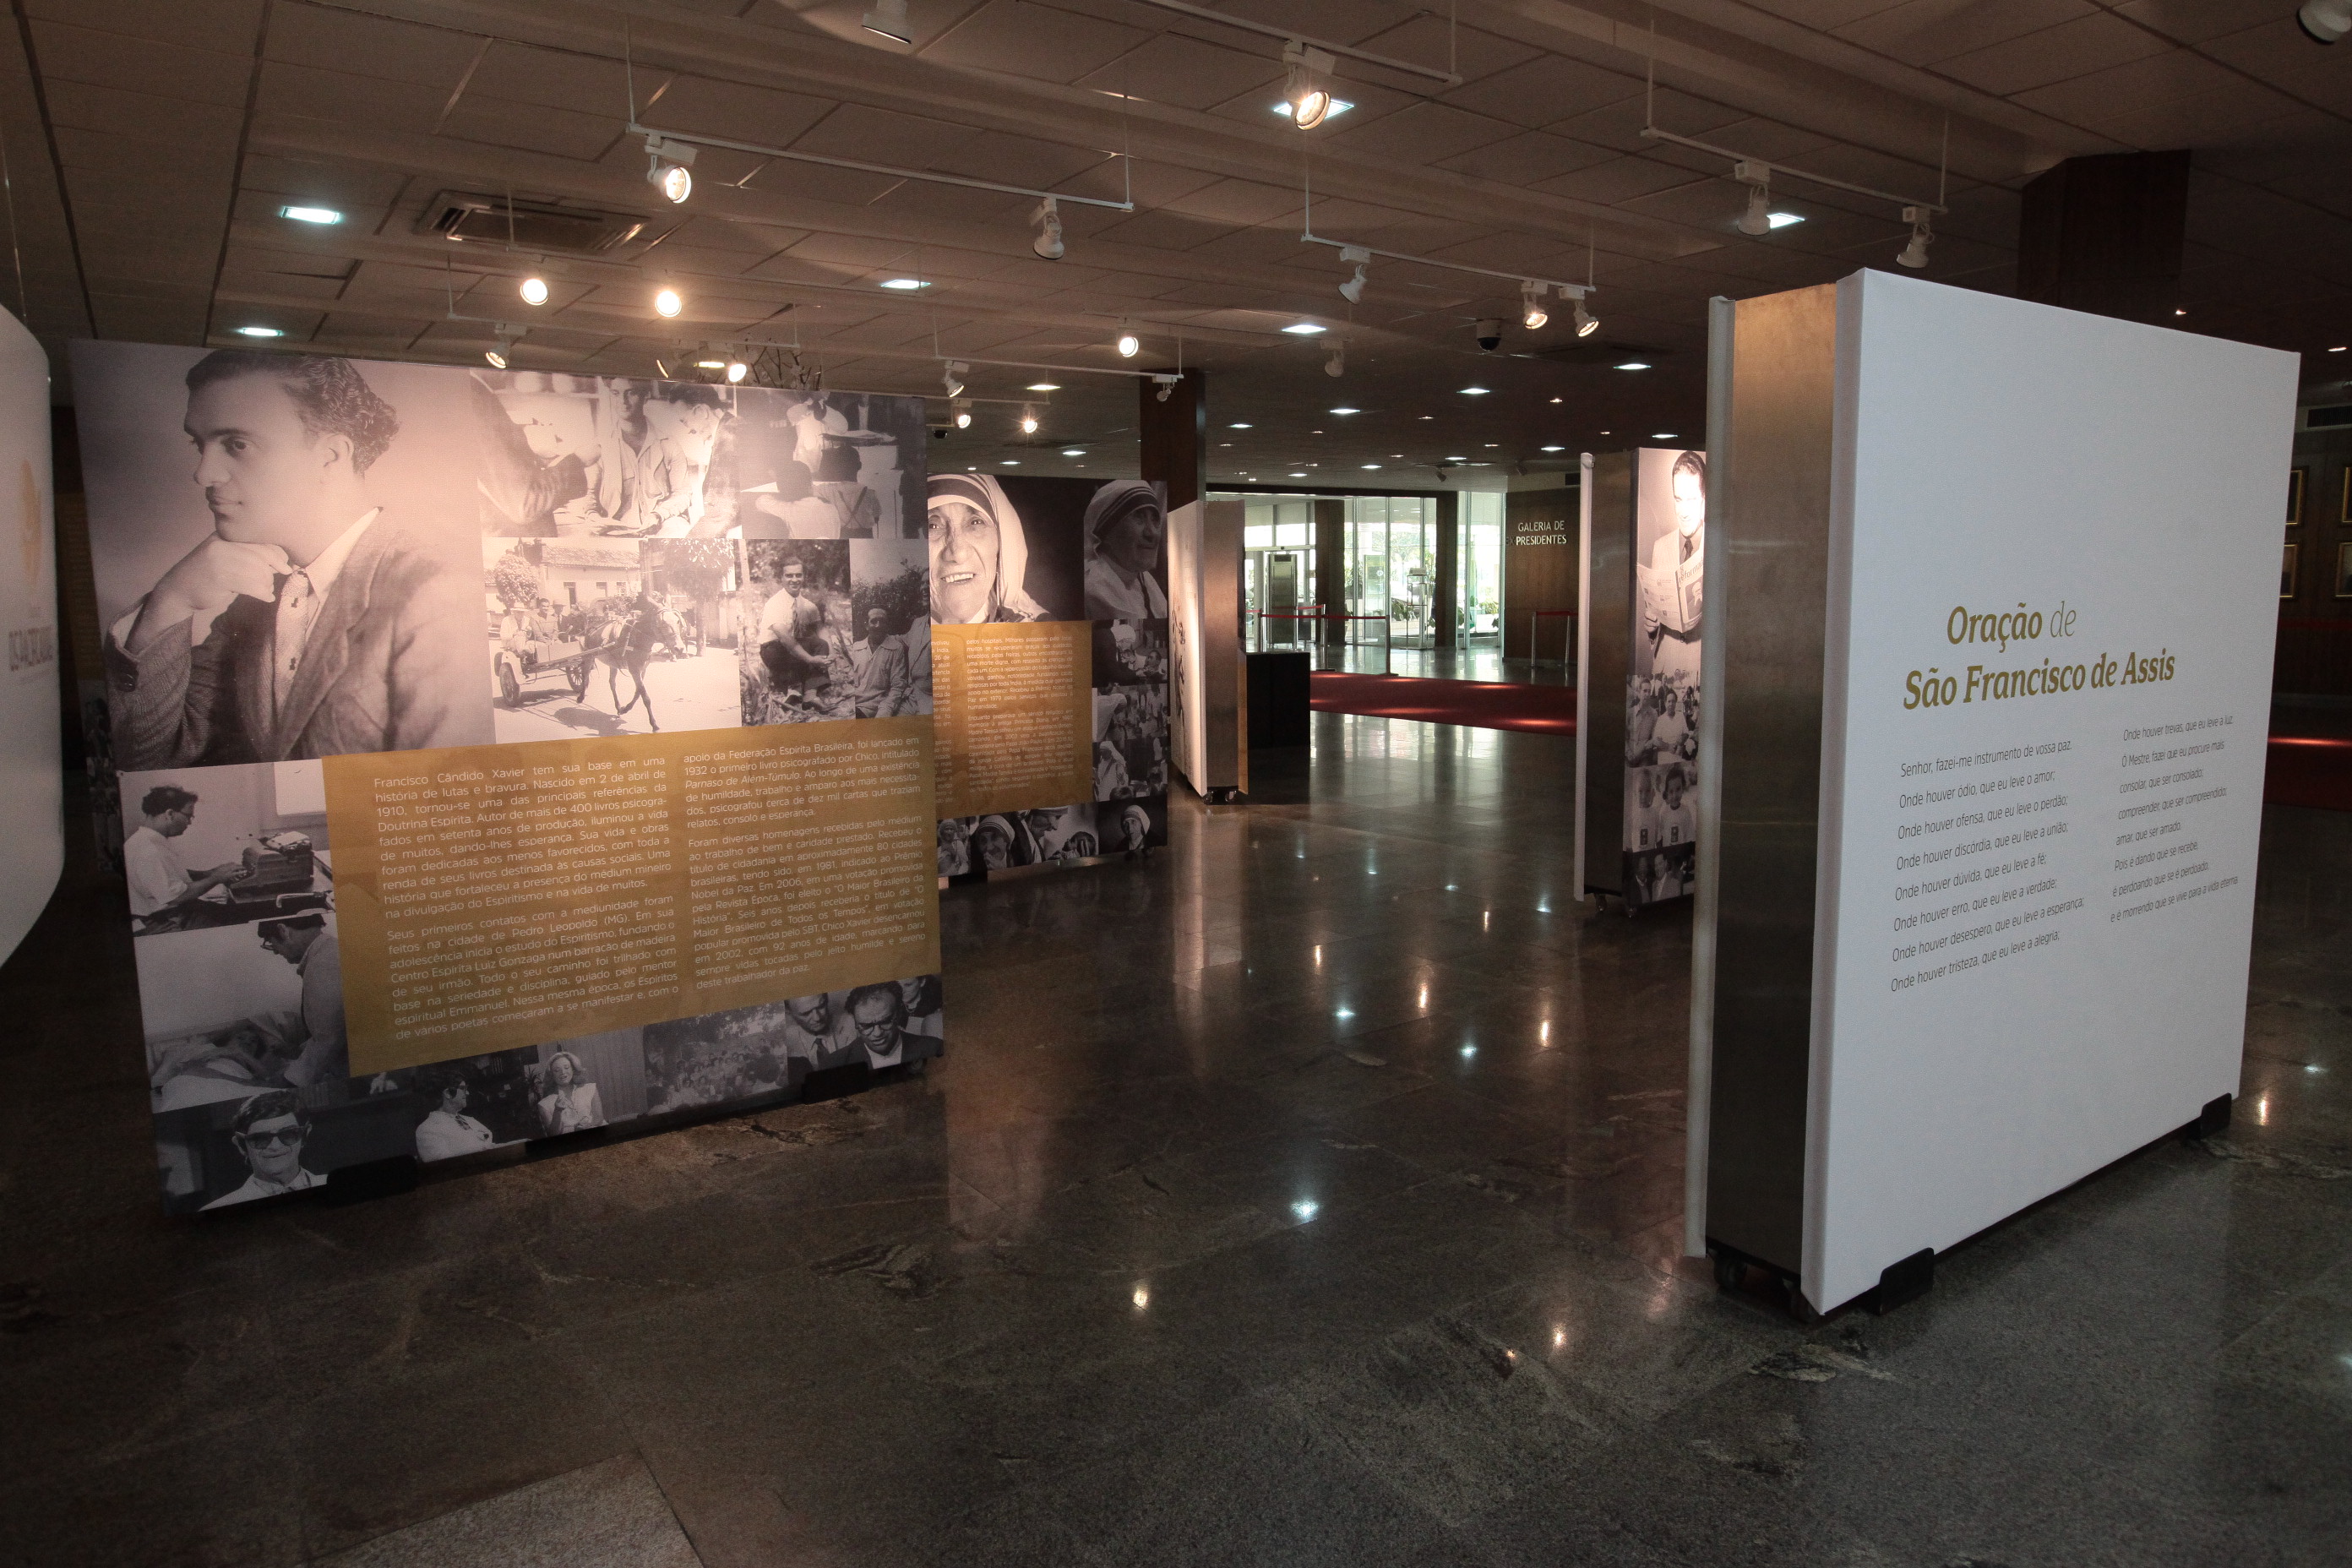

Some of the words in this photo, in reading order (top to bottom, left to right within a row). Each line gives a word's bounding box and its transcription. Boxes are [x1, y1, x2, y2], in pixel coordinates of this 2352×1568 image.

[1516, 535, 1567, 546] PRESIDENTES
[1518, 522, 1551, 531] GALERIA
[1554, 520, 1565, 531] DE
[1946, 602, 2043, 653] Oração
[2050, 601, 2077, 638] de
[1903, 667, 1957, 710] São
[1963, 657, 2086, 703] Francisco
[2091, 652, 2117, 689] de
[2121, 648, 2175, 685] Assis
[683, 754, 710, 763] apoio
[729, 749, 776, 759] Federação
[780, 746, 811, 755] Espírita
[858, 740, 868, 749] foi
[871, 738, 903, 748] lançado
[1901, 761, 1933, 777] Senhor,
[1936, 756, 1972, 771] fazei-me
[1974, 748, 2022, 765] instrumento
[2023, 744, 2034, 758] de
[2036, 743, 2055, 755] vossa
[2058, 740, 2072, 753] paz.
[374, 776, 428, 787] Francisco
[438, 771, 484, 783] Cândido
[492, 769, 525, 778] Xavier
[562, 765, 580, 773] sua
[588, 762, 612, 770] base
[644, 758, 665, 766] uma
[375, 792, 417, 802] história
[422, 789, 438, 798] de
[443, 787, 469, 797] lutas
[533, 777, 574, 789] Nascido
[600, 774, 606, 783] 2
[611, 774, 623, 782] de
[628, 770, 649, 781] abril
[653, 770, 666, 779] de
[1899, 792, 1923, 808] Onde
[1926, 788, 1955, 803] houver
[1957, 783, 1977, 798] ódio,
[1980, 781, 1995, 795] que
[1998, 780, 2007, 791] eu
[2010, 776, 2025, 788] leve
[2027, 775, 2032, 785] o
[2034, 771, 2055, 784] amor;
[378, 819, 427, 832] Doutrina
[476, 813, 506, 822] Autor
[509, 810, 523, 819] de
[526, 808, 551, 817] mais
[553, 806, 567, 814] de
[570, 803, 592, 813] 400
[623, 798, 667, 809] psicogra-
[415, 802, 470, 814] tornou-se
[478, 799, 503, 808] uma
[510, 797, 530, 805] das
[537, 792, 586, 803] principais
[593, 787, 647, 798] referências
[654, 783, 667, 792] da
[1898, 823, 1922, 840] Onde
[1925, 819, 1953, 833] houver
[1956, 813, 1984, 828] ofensa,
[1987, 808, 2002, 821] que
[2005, 807, 2014, 818] eu
[2017, 803, 2032, 814] leve
[2034, 801, 2039, 812] o
[2041, 795, 2068, 811] perdão;
[1897, 853, 1920, 870] Onde
[1923, 848, 1952, 864] houver
[1955, 839, 1992, 857] discórdia,
[1995, 836, 2010, 848] que
[2012, 834, 2021, 844] eu
[2023, 829, 2039, 841] leve
[2040, 827, 2044, 837] a
[2047, 822, 2068, 836] união;
[1895, 885, 1919, 901] Onde
[1922, 878, 1951, 895] houver
[1953, 869, 1982, 886] dúvida,
[1984, 866, 2000, 879] que
[2001, 863, 2012, 874] eu
[2014, 859, 2028, 871] leve
[2030, 858, 2035, 867] a
[2038, 853, 2046, 865] fé;
[1894, 914, 1918, 932] Onde
[1920, 907, 1949, 924] houver
[1952, 902, 1970, 916] erro,
[1973, 897, 1988, 911] que
[1990, 895, 2000, 906] eu
[2002, 890, 2017, 901] leve
[2019, 887, 2023, 897] a
[2027, 878, 2057, 896] verdade;
[1892, 945, 1916, 962] Onde
[1919, 937, 1948, 954] houver
[1950, 924, 1992, 945] desespero,
[1995, 918, 2010, 932] que
[2012, 916, 2022, 927] eu
[2024, 911, 2039, 923] leve
[2040, 908, 2044, 918] a
[2047, 898, 2084, 917] esperança;
[1891, 975, 1914, 992] Onde
[1918, 966, 1946, 983] houver
[1949, 956, 1979, 974] tristeza,
[1982, 950, 1997, 964] que
[1999, 947, 2008, 958] eu
[2011, 941, 2026, 954] leve
[2028, 939, 2033, 949] a
[2034, 931, 2060, 947] alegria;
